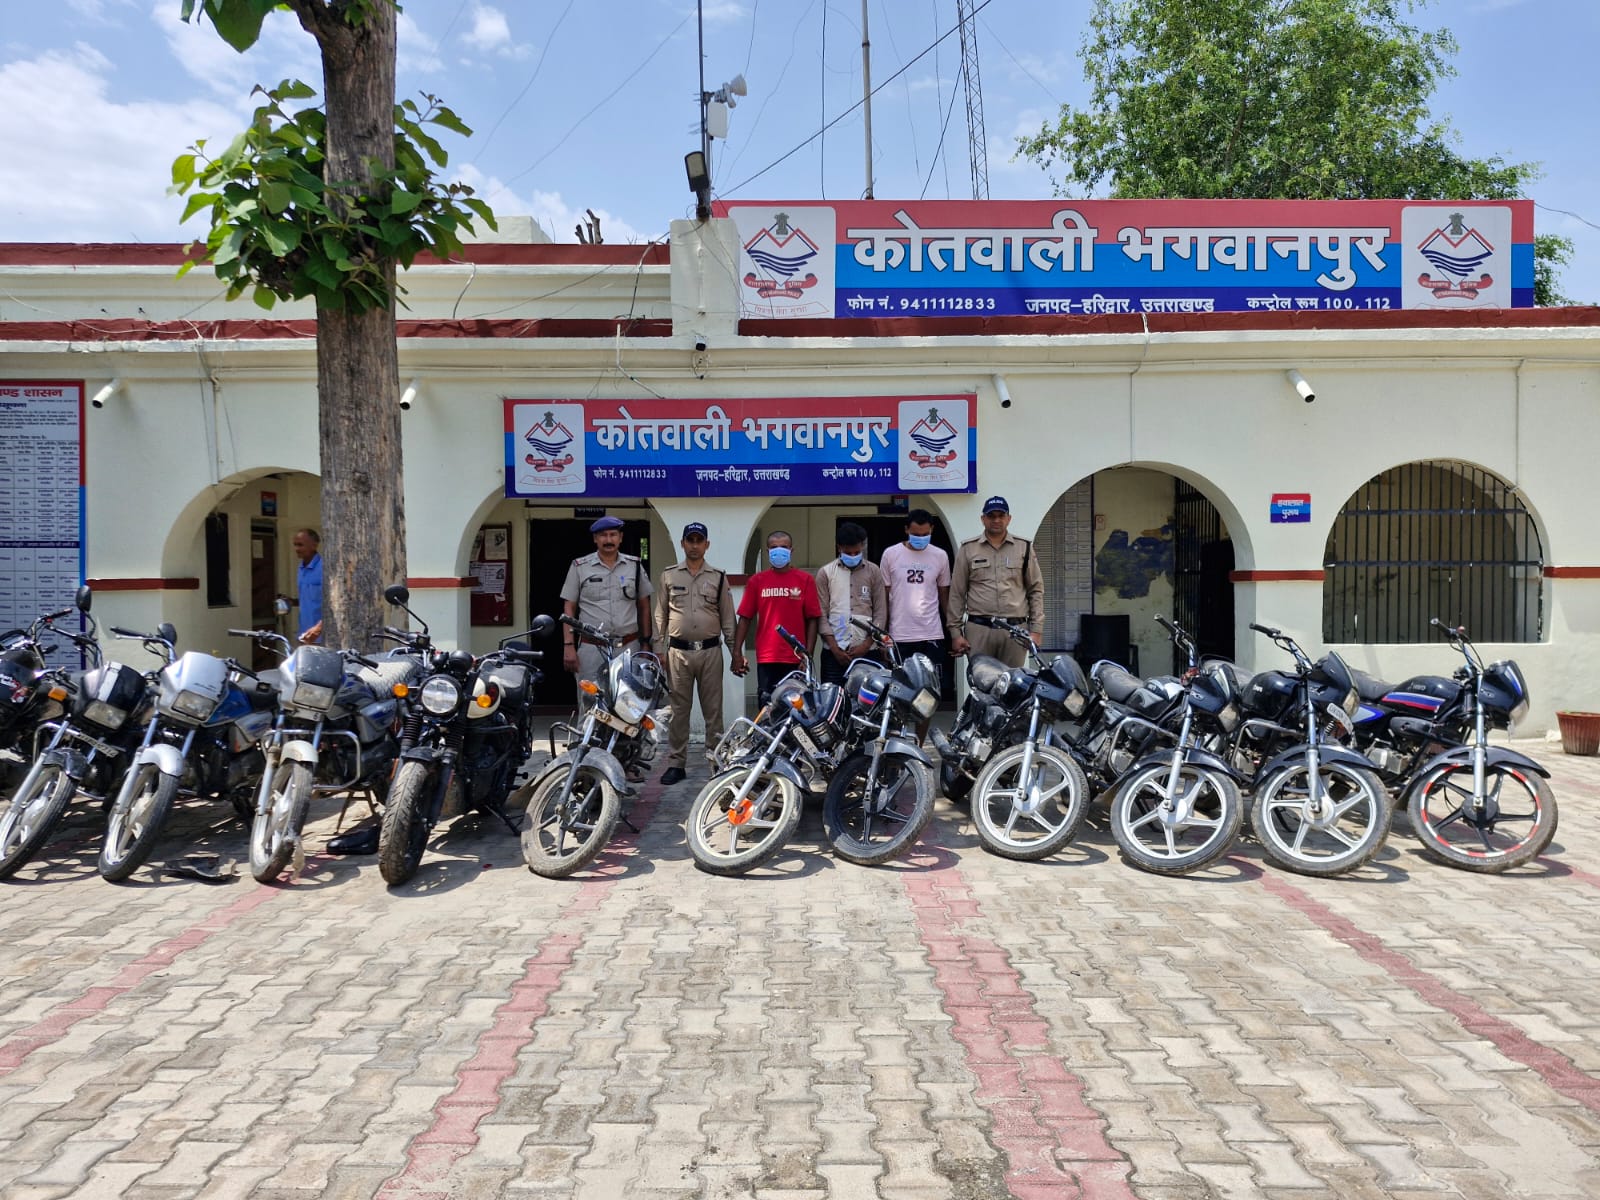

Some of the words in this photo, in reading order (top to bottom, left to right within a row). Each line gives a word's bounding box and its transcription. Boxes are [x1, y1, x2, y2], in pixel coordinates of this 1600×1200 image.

[846, 209, 1098, 272] कोतवाली
[1116, 226, 1391, 291] भगवानपुर
[848, 294, 874, 310] फोन
[900, 298, 996, 310] 9411112833
[1140, 299, 1215, 313] उत्तराखण्ड
[1323, 298, 1359, 310] 100,
[1365, 298, 1390, 310] 112
[592, 405, 731, 450] कोतवाली
[742, 416, 892, 463] भगवानपुर
[593, 466, 607, 478] फोन
[619, 469, 666, 478] 9411112833
[752, 468, 790, 481] उत्तराखण्ड
[859, 468, 877, 478] 100,
[879, 467, 892, 477] 112
[906, 569, 925, 584] 23
[761, 587, 790, 598] ADIDAS
